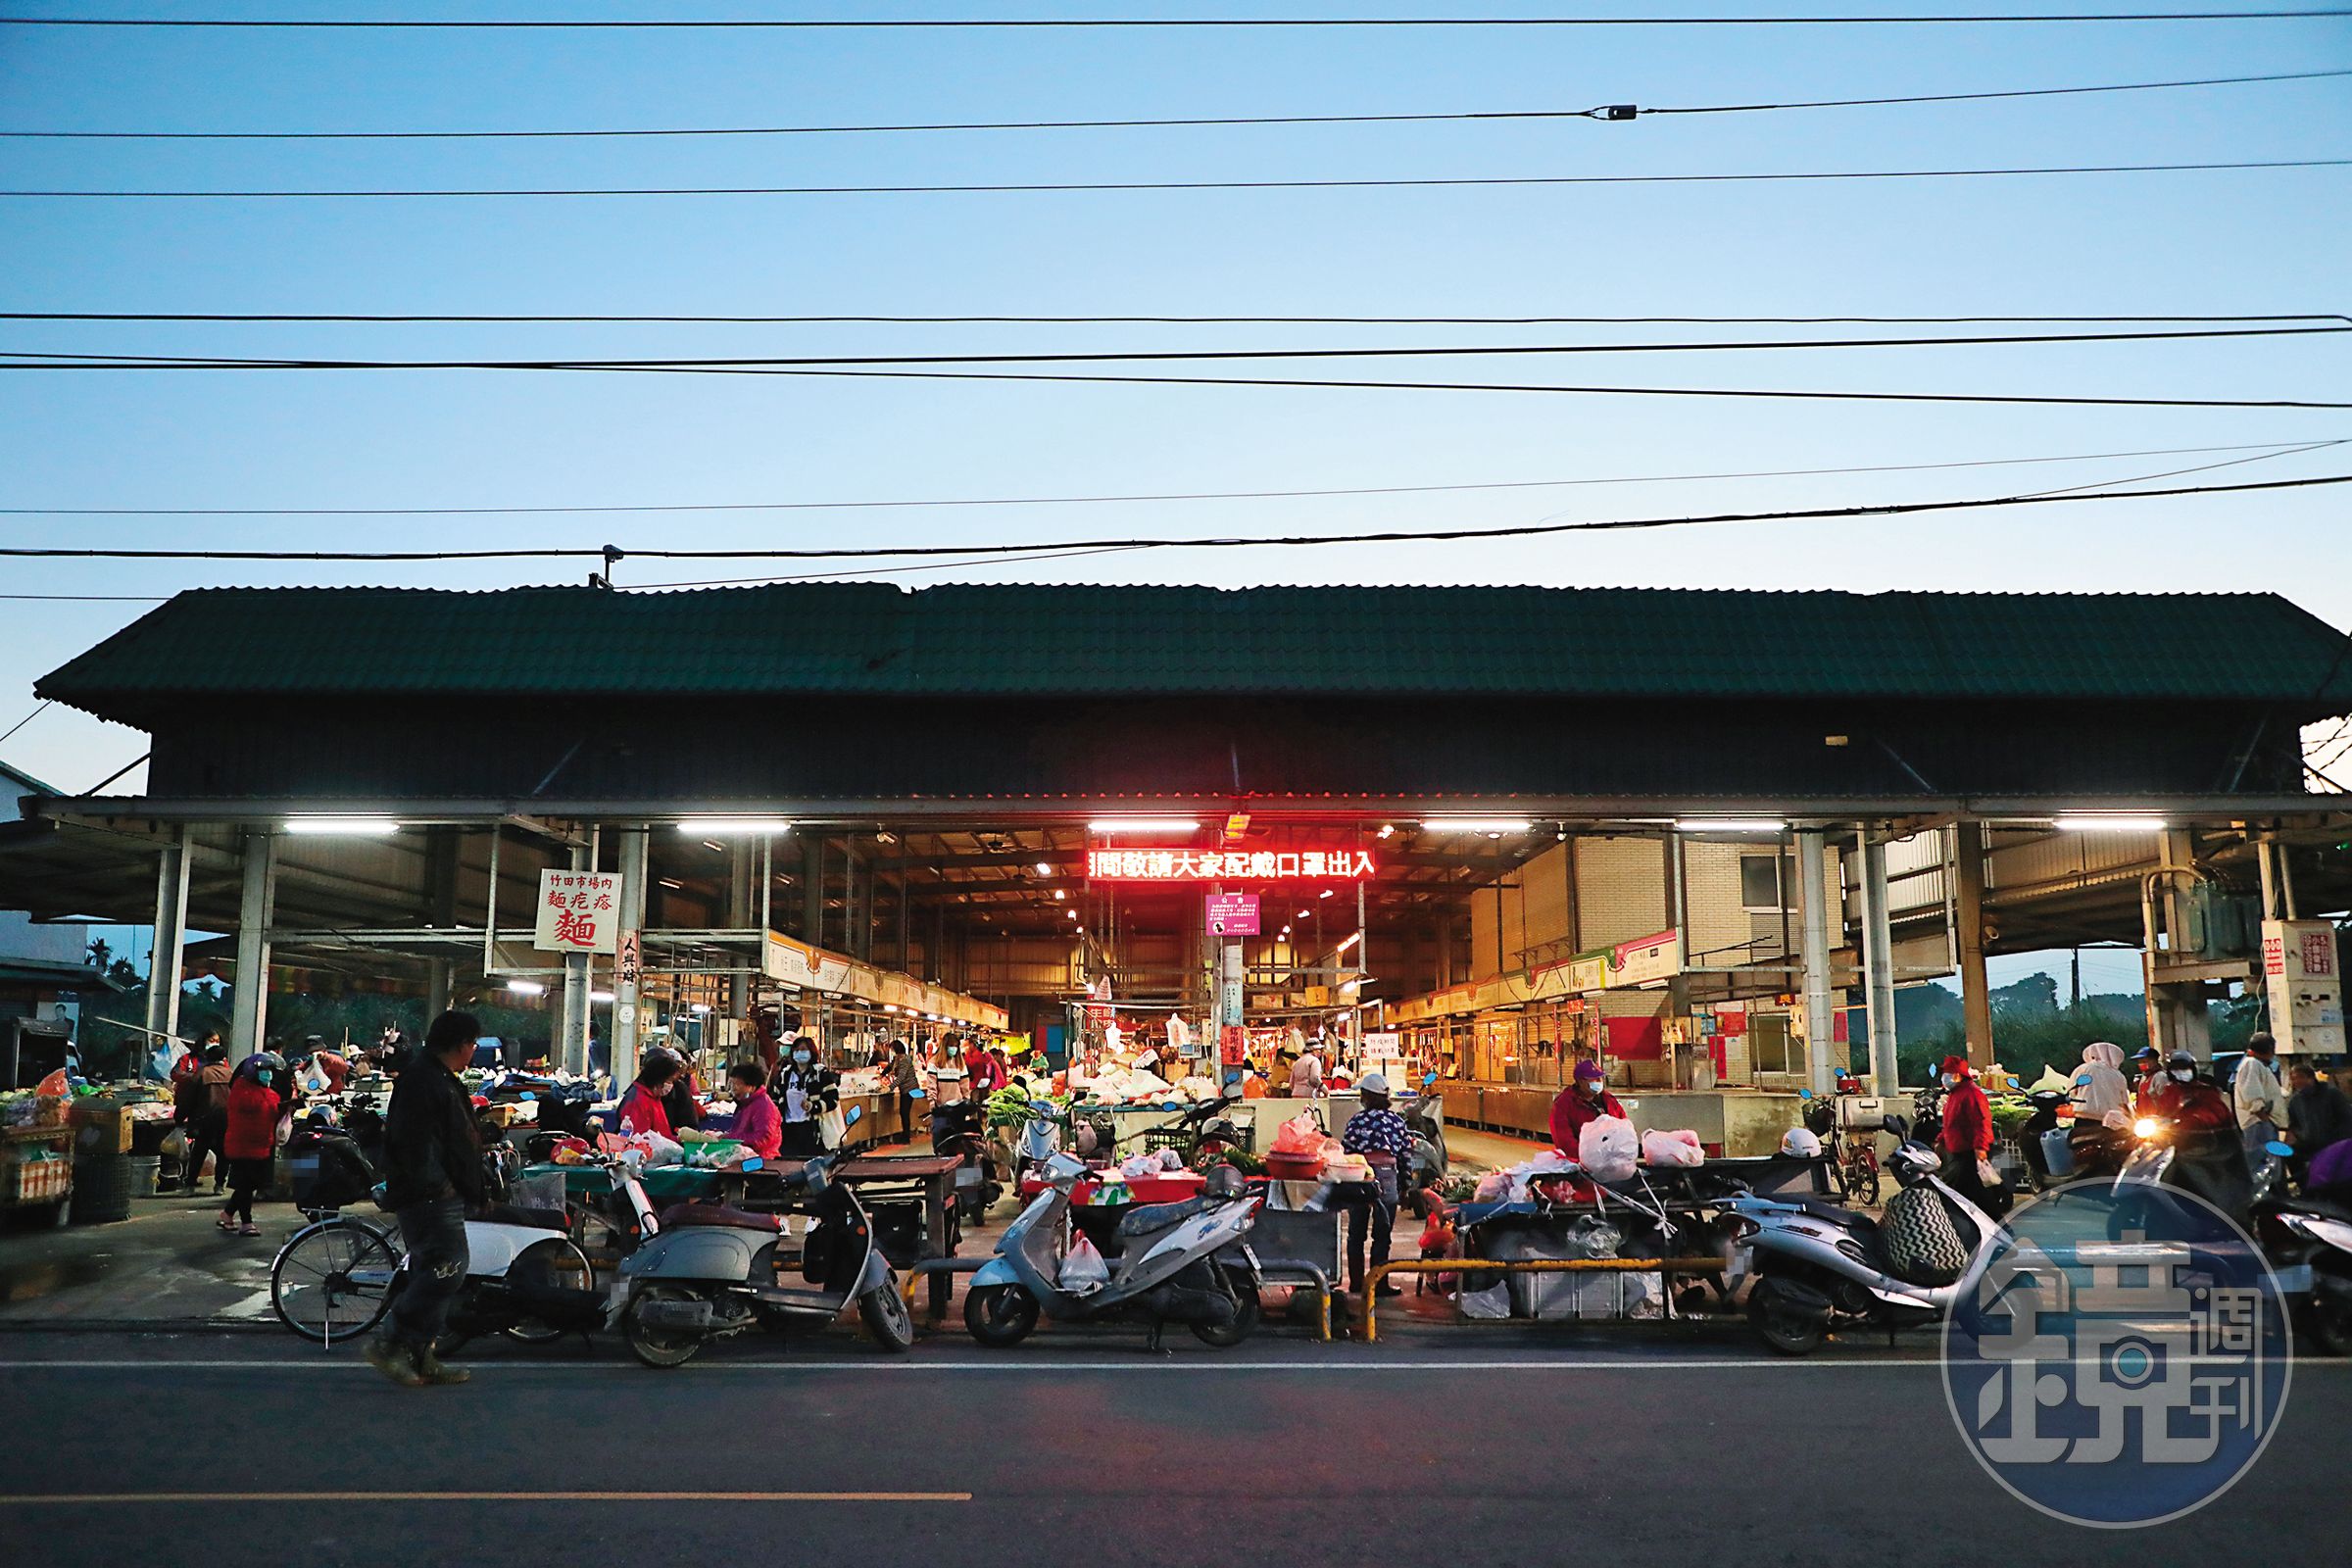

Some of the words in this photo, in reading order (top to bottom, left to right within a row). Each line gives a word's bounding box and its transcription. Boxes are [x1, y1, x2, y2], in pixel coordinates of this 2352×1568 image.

[1089, 851, 1375, 878] 間敬請大家配戴口罩出入
[550, 874, 612, 890] 竹田市場內
[547, 890, 612, 910] 麵疙瘩
[554, 908, 597, 947] 麵
